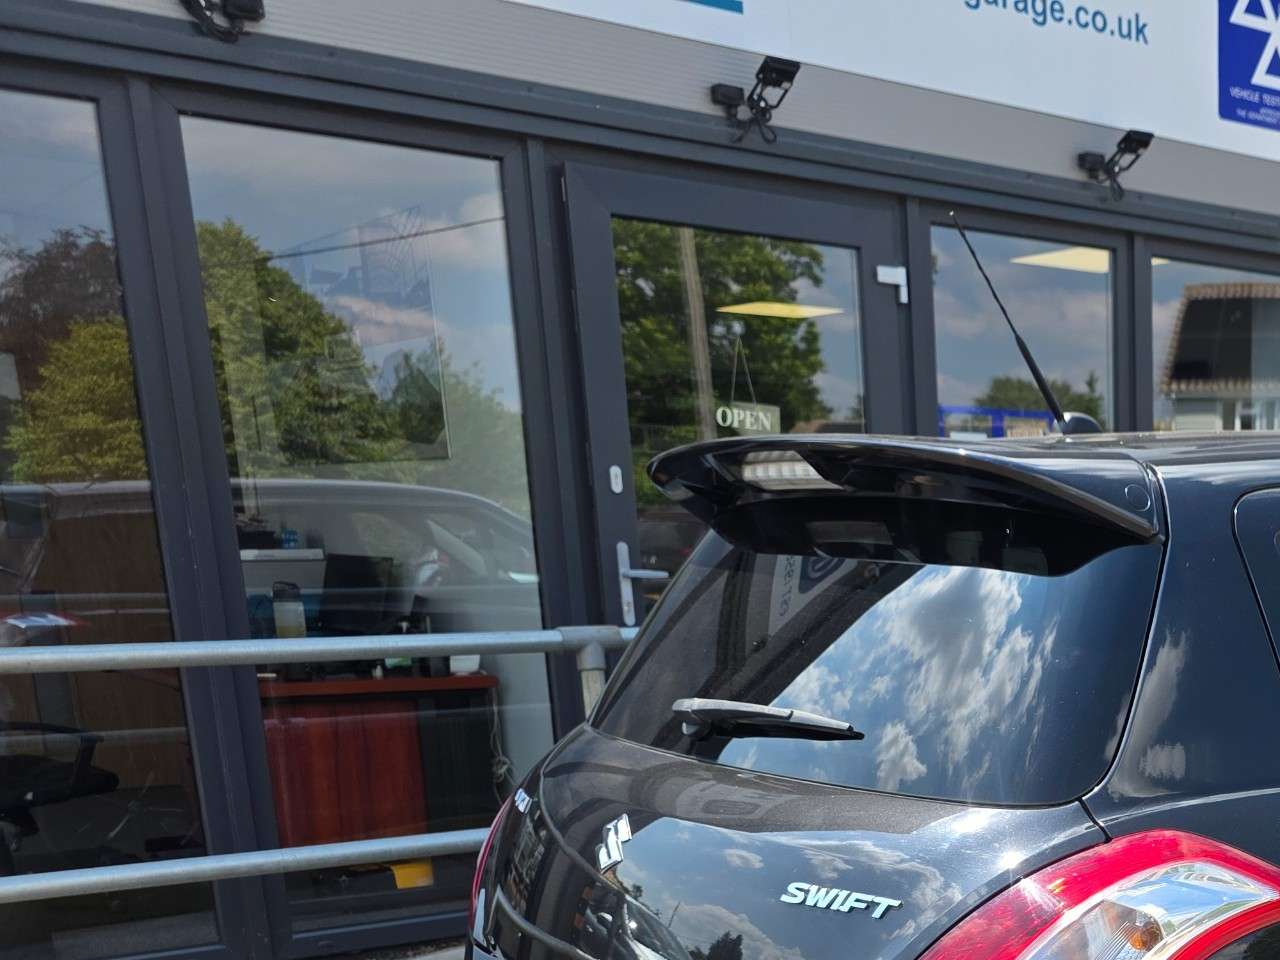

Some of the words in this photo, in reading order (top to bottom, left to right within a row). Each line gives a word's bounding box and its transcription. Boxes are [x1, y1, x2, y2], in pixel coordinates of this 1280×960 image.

[1229, 86, 1260, 103] VEHICLE
[716, 406, 771, 432] OPEN
[780, 882, 902, 919] SWIFT
